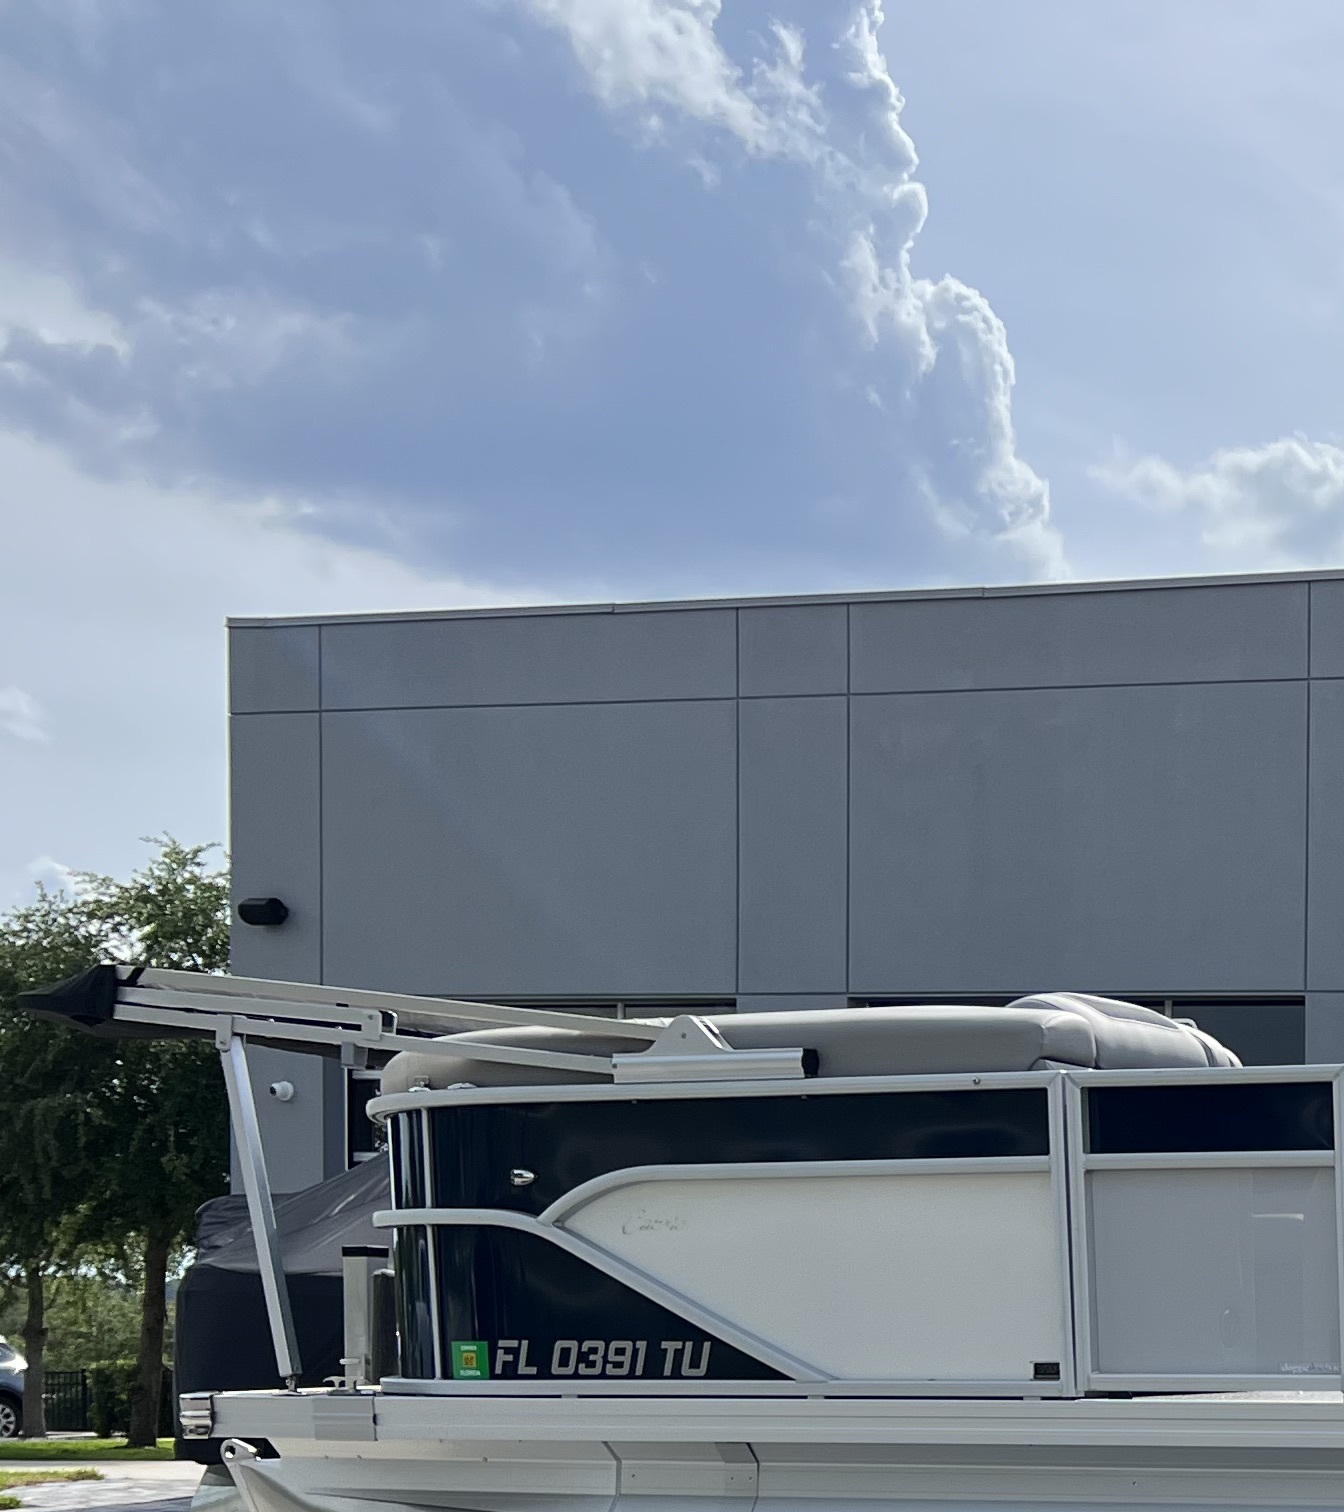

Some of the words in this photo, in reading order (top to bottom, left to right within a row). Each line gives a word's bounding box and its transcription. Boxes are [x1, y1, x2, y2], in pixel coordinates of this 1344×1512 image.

[494, 1339, 538, 1375] FL
[550, 1339, 648, 1377] 0391
[660, 1340, 713, 1377] TU
